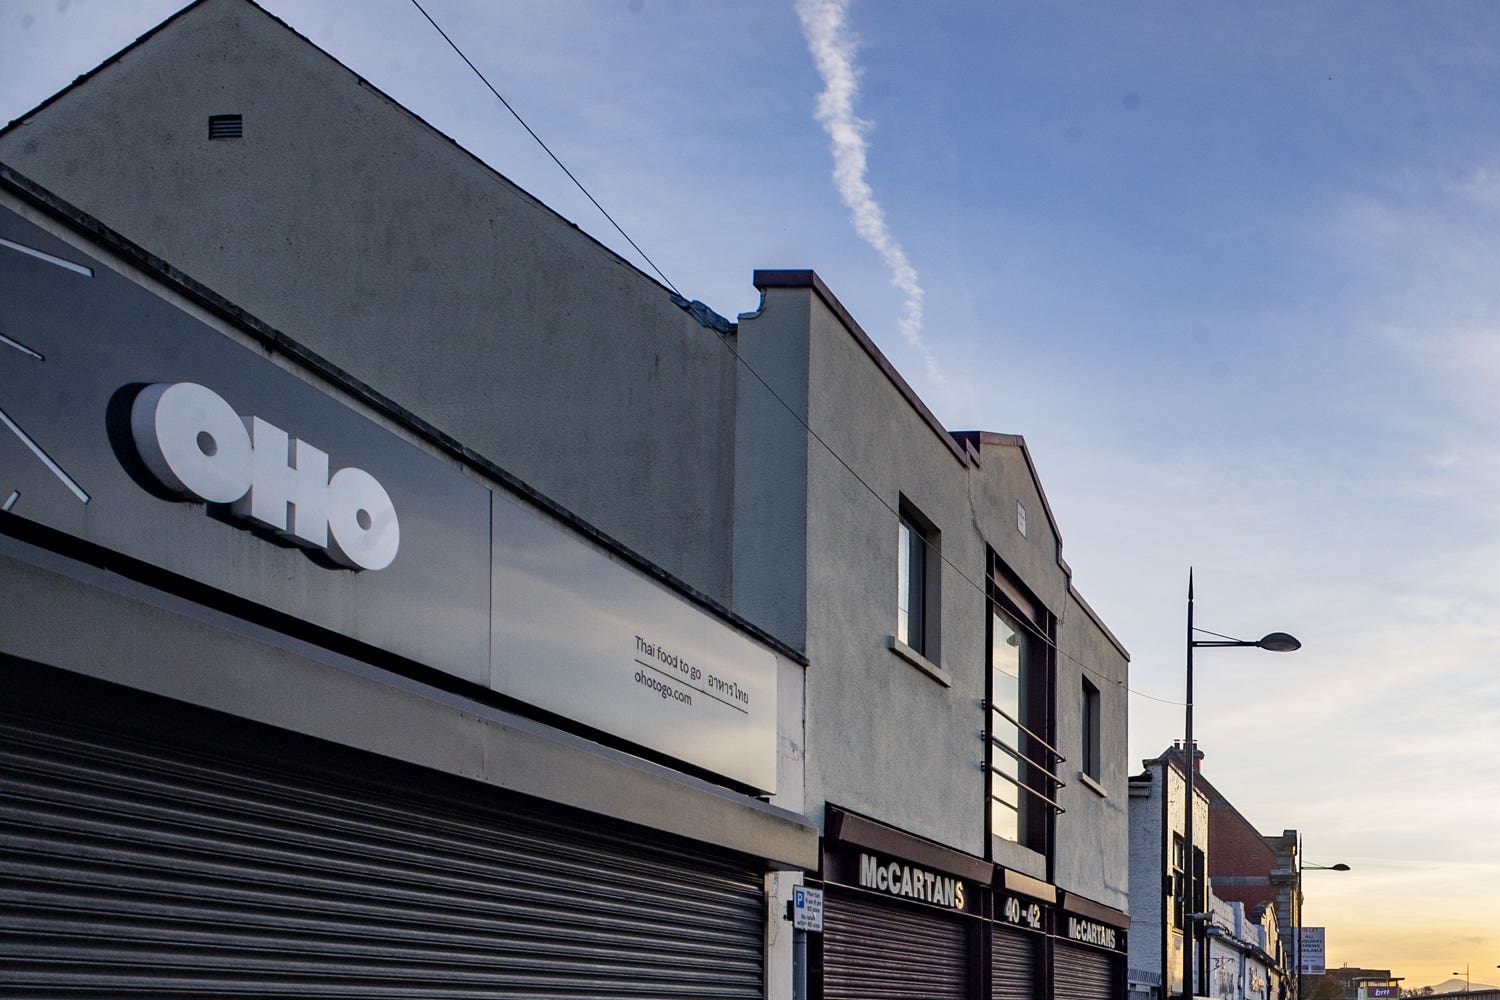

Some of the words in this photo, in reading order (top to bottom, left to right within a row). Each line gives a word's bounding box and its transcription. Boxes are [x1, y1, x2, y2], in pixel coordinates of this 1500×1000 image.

[131, 382, 401, 572] OHO
[635, 635, 655, 657] Thai
[657, 646, 678, 669] food
[680, 658, 689, 674] to
[690, 667, 702, 681] go
[634, 669, 692, 705] ohotogo.com
[859, 853, 964, 910] McCARTANS
[1068, 917, 1116, 949] McCARTANS
